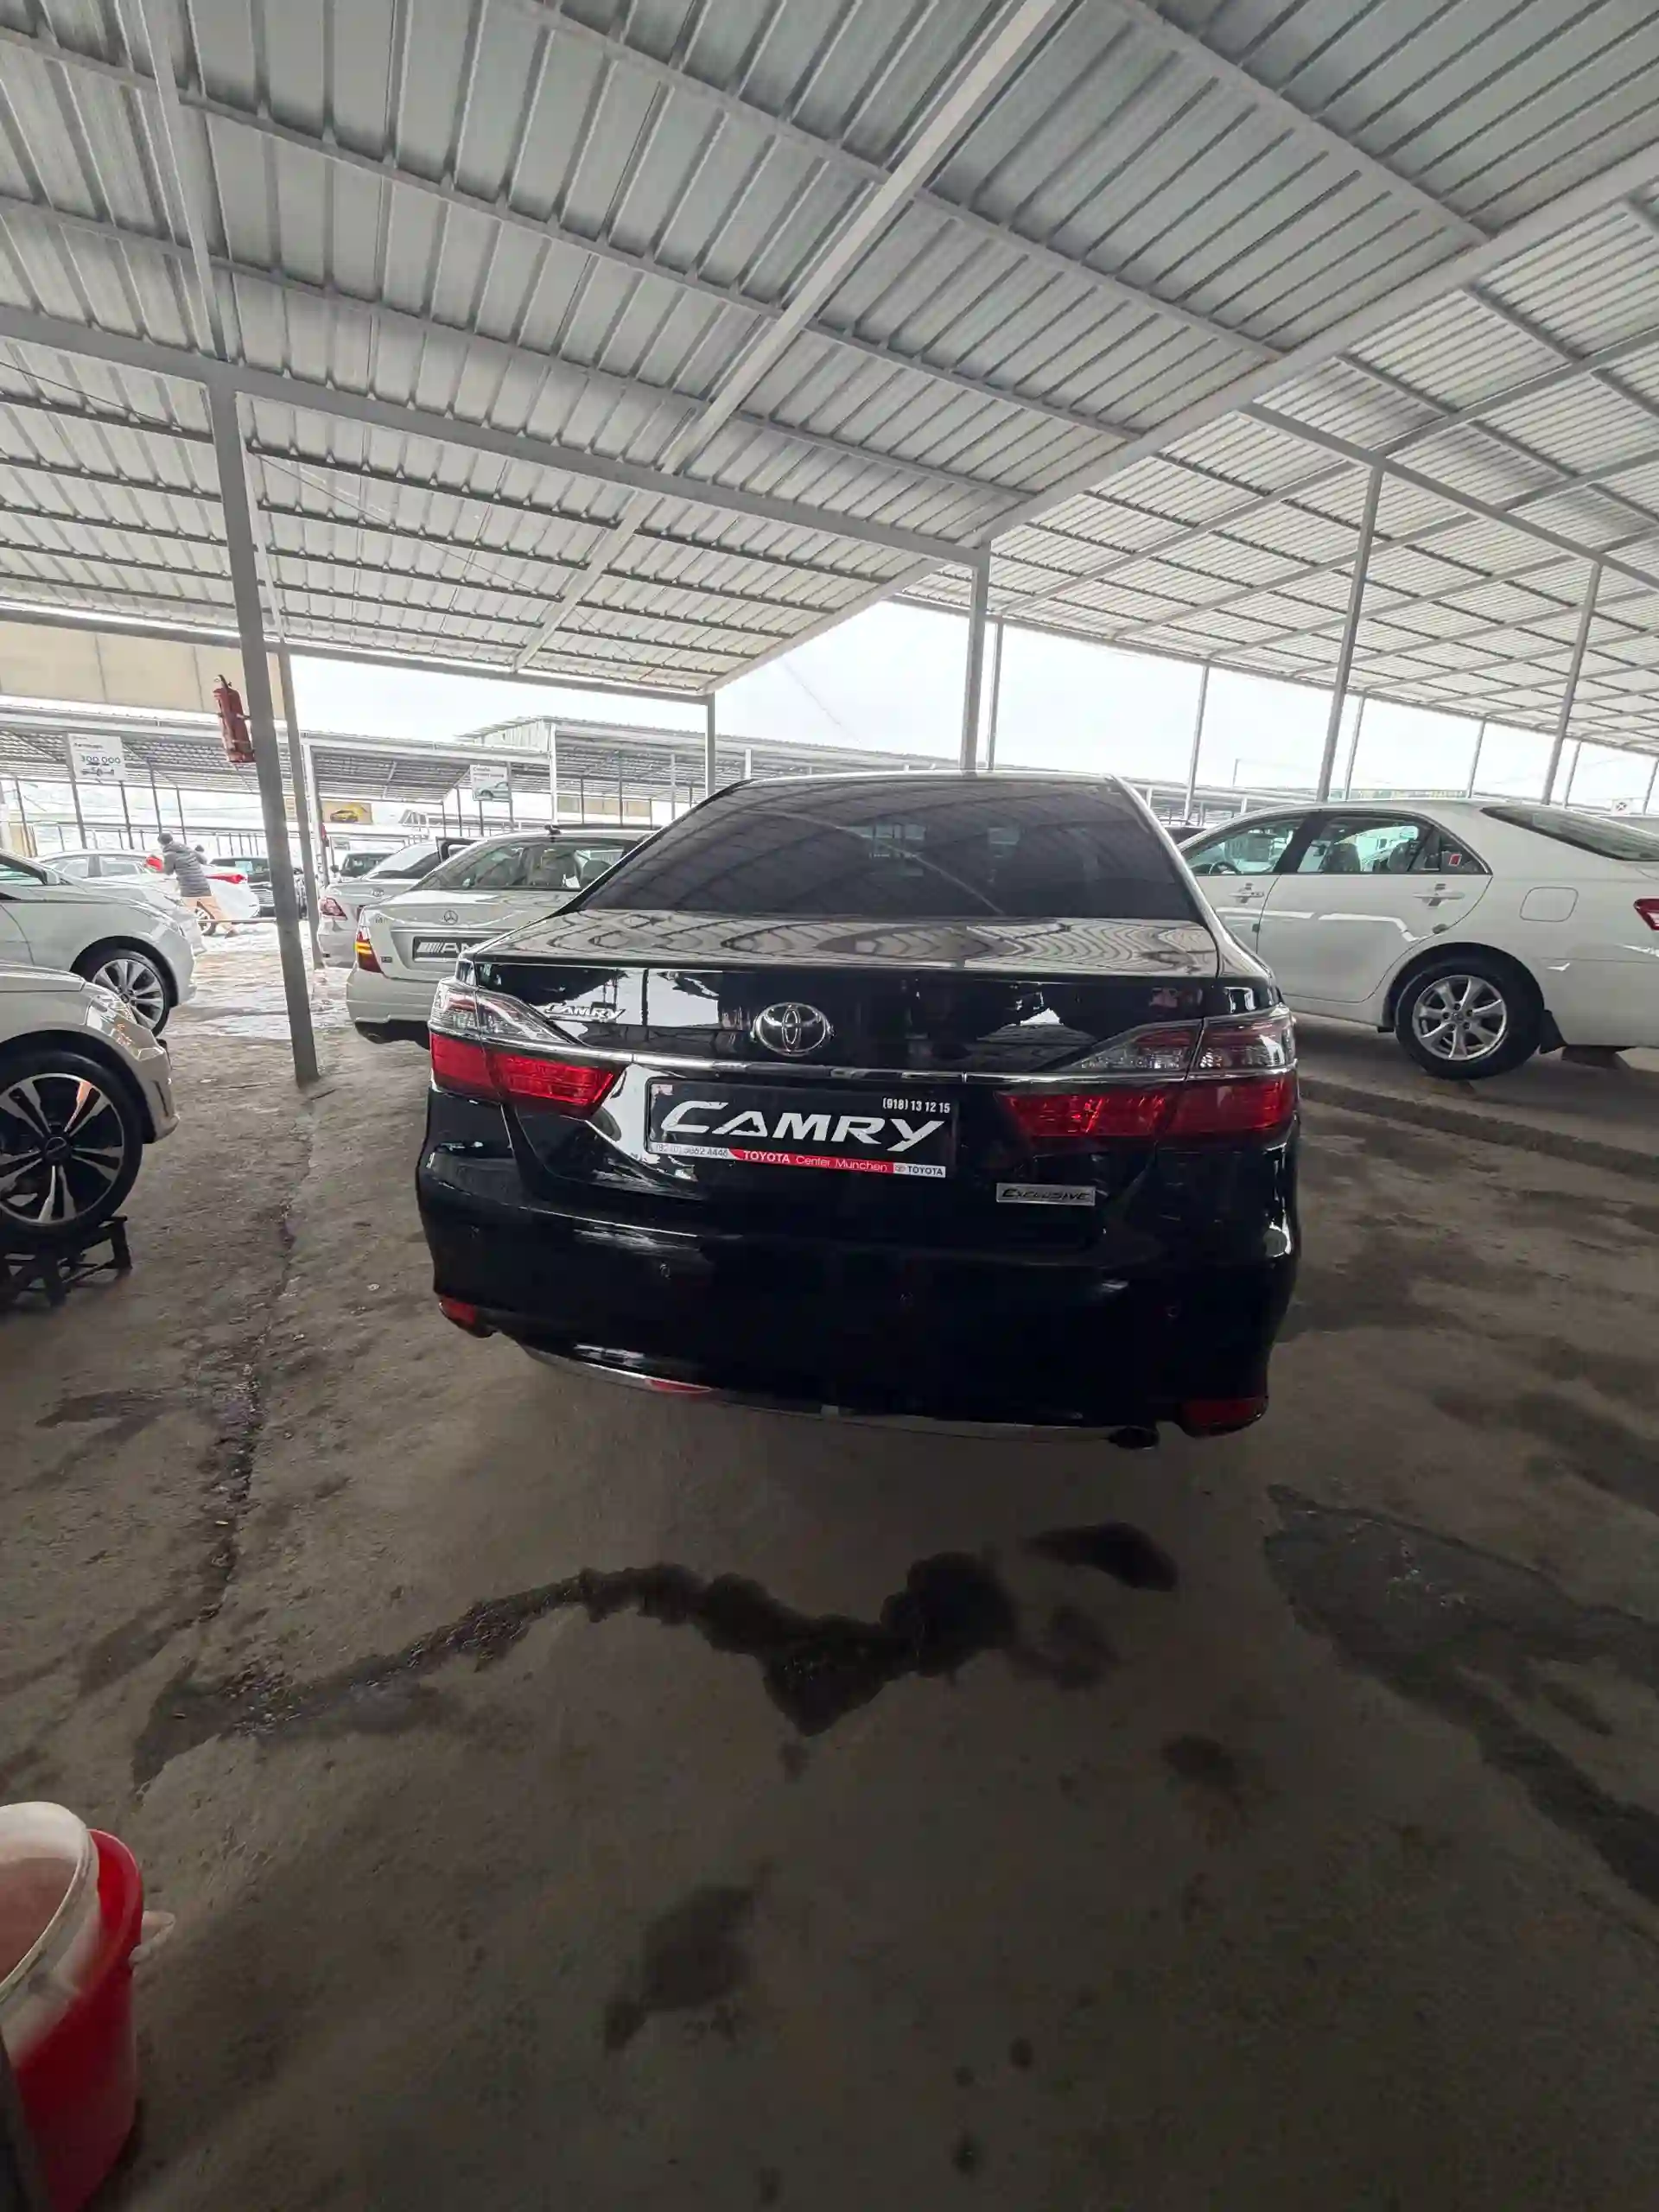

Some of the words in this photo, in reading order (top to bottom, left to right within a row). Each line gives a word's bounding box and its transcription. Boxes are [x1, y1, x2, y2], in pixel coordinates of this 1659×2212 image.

[544, 1002, 626, 1022] CAMRY
[882, 1097, 908, 1109] (918)
[911, 1100, 922, 1111] 13
[925, 1102, 937, 1113] 12
[939, 1103, 950, 1114] 15
[661, 1100, 946, 1152] CAMRY
[743, 1150, 791, 1164] TOYOTA
[796, 1155, 830, 1167] Center
[908, 1166, 944, 1176] TOYOTA
